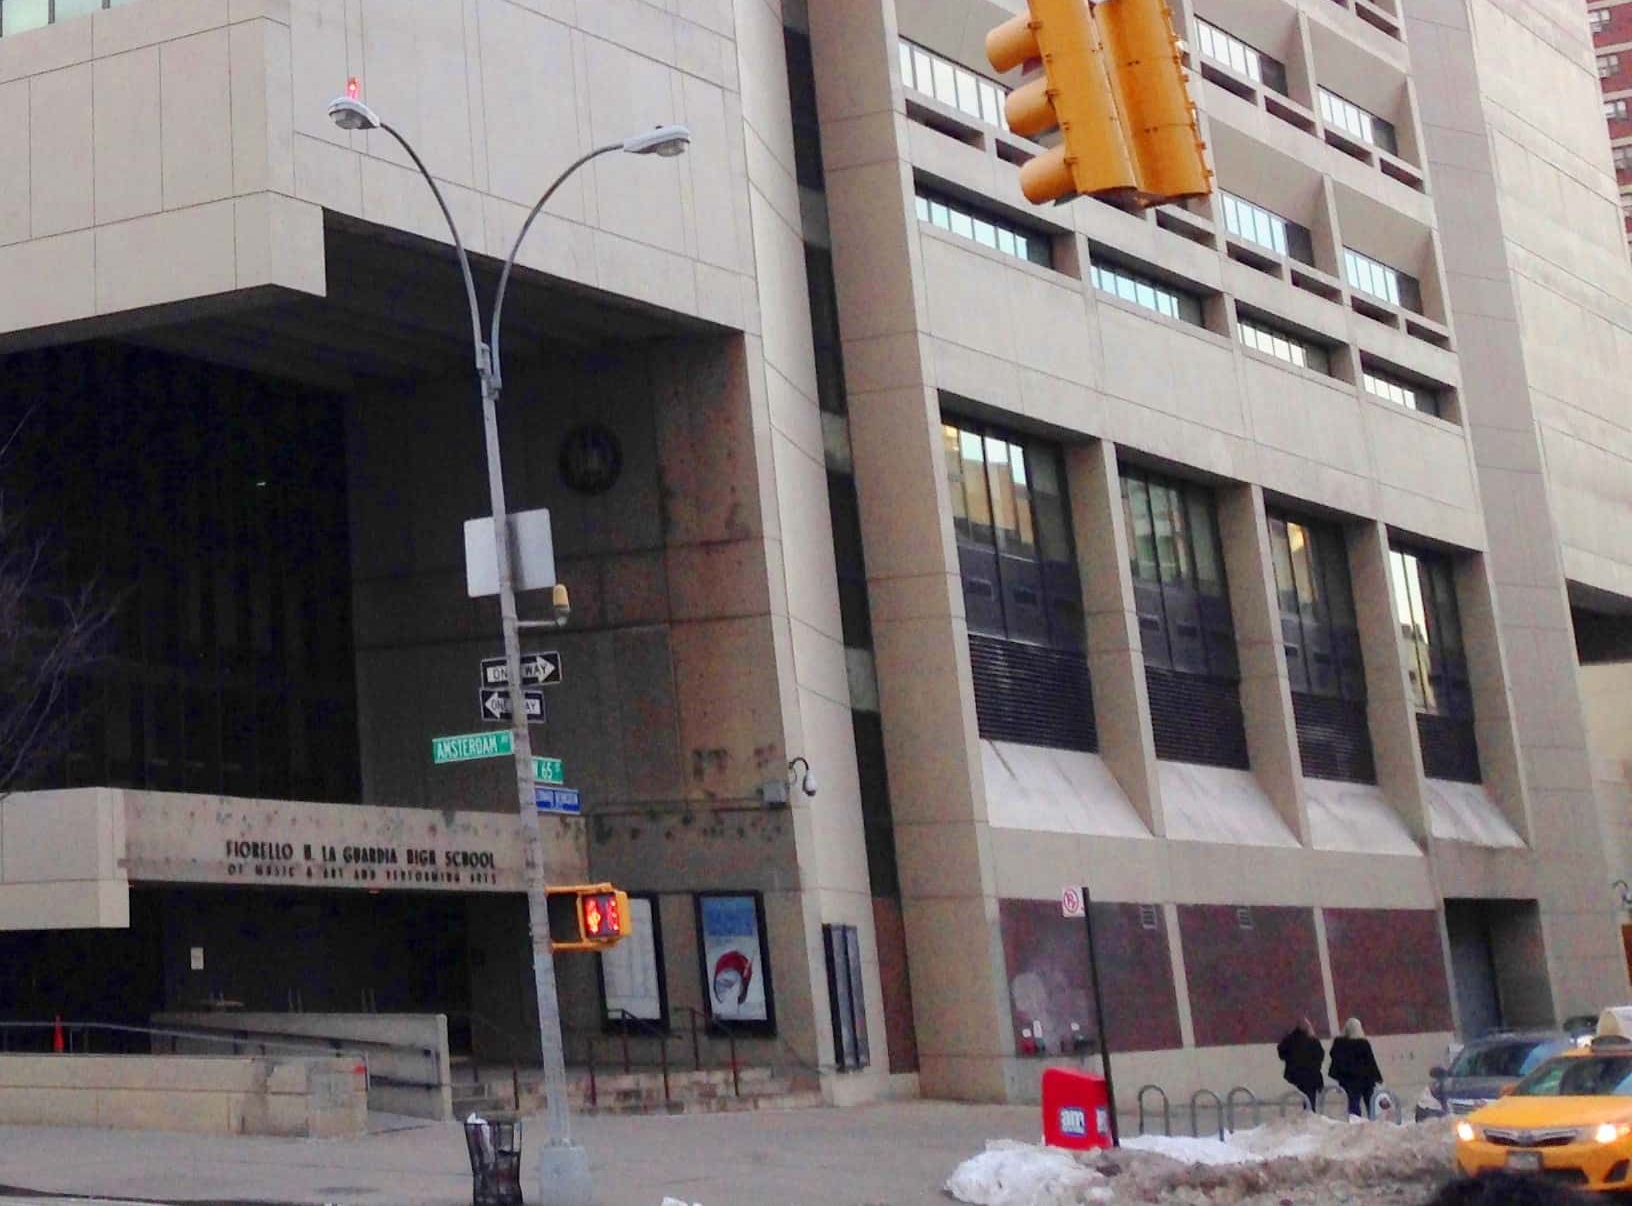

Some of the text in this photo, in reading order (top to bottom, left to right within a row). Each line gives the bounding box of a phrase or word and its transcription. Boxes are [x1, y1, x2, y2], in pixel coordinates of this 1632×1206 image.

[525, 664, 546, 676] WAY
[437, 737, 498, 759] AMSTERDAM
[541, 761, 553, 780] 65
[226, 841, 294, 861] FIORELLO
[321, 845, 337, 863] LA
[342, 846, 398, 865] GUARDIA
[406, 849, 437, 867] HIGH
[445, 850, 496, 870] SCHOOL
[255, 865, 295, 879] MUSIC
[386, 870, 461, 884] PERFORMING
[469, 872, 497, 885] ARTS
